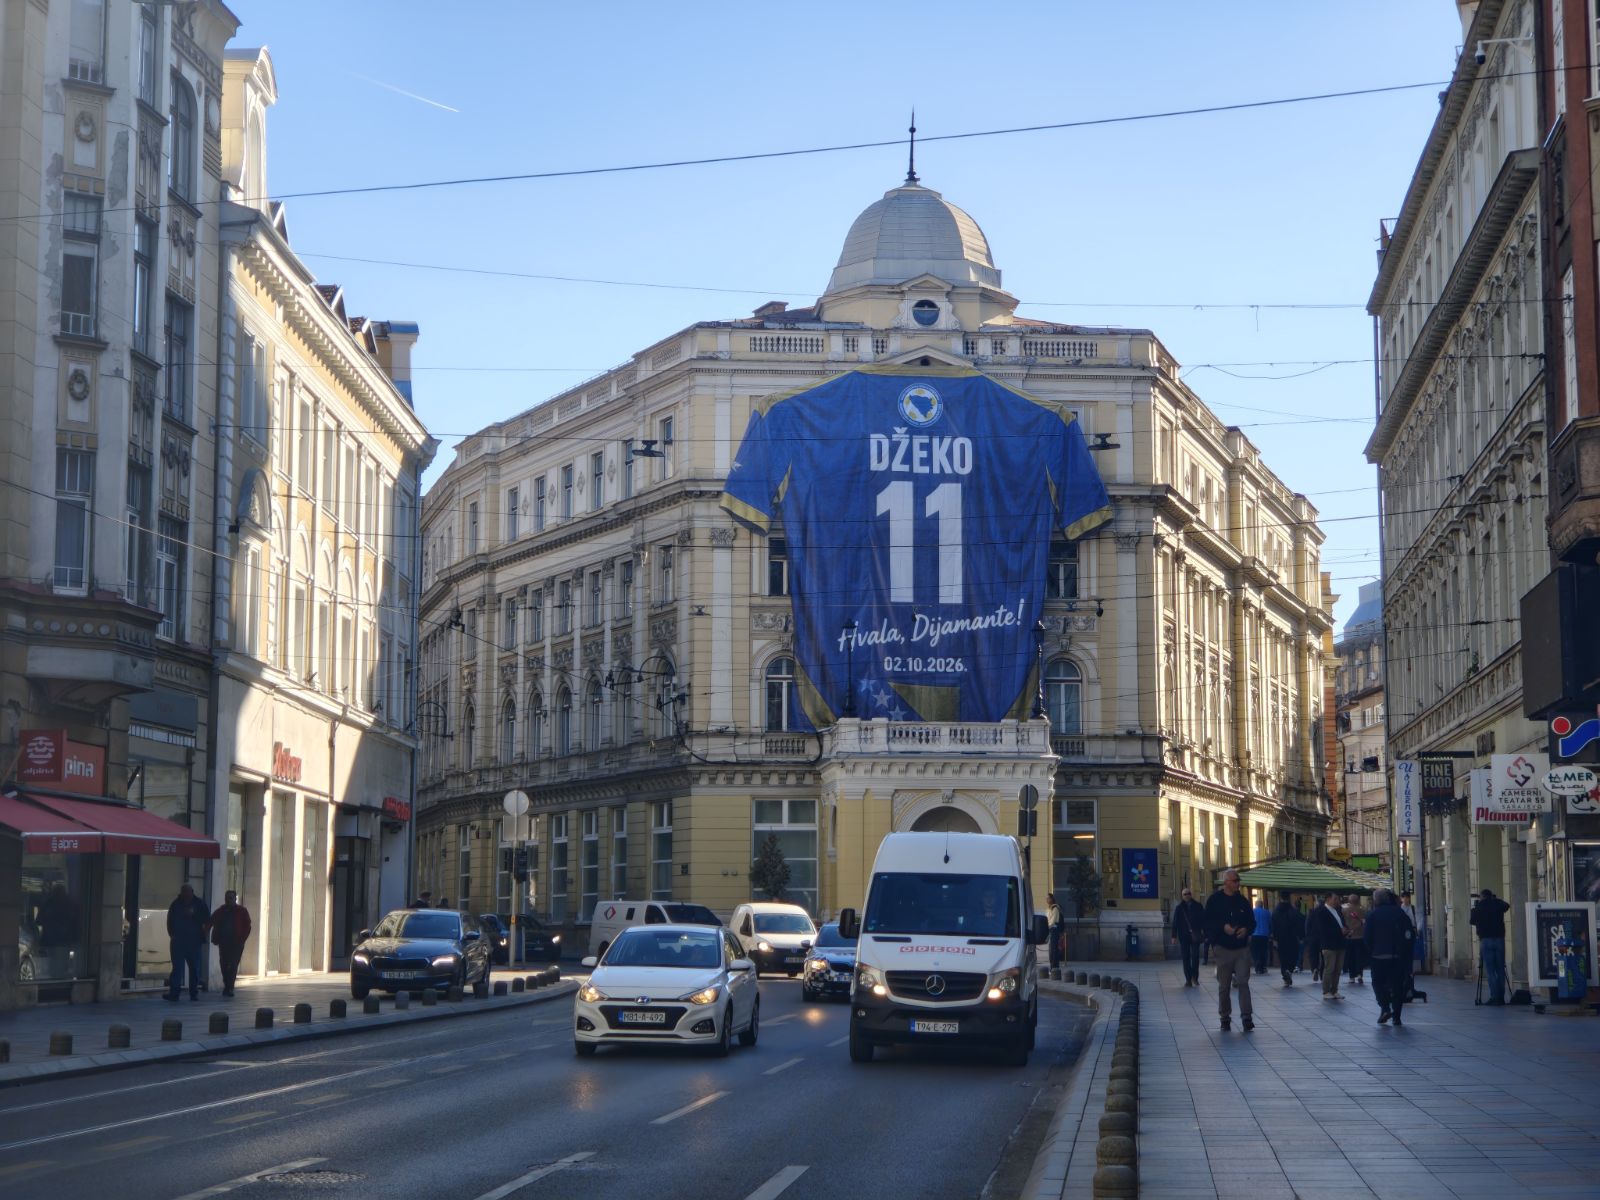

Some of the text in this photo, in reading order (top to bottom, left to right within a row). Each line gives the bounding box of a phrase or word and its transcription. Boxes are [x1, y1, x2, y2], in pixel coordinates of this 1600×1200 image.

[870, 427, 973, 475] DŽEKO
[876, 481, 962, 604] 11
[838, 599, 1025, 652] Hvala, Dijamante!
[884, 656, 968, 673] 02.10.2026.
[1423, 763, 1452, 777] FINE
[1564, 772, 1593, 782] MER
[1424, 777, 1452, 789] FOOD
[916, 1022, 958, 1032] T94-E-275
